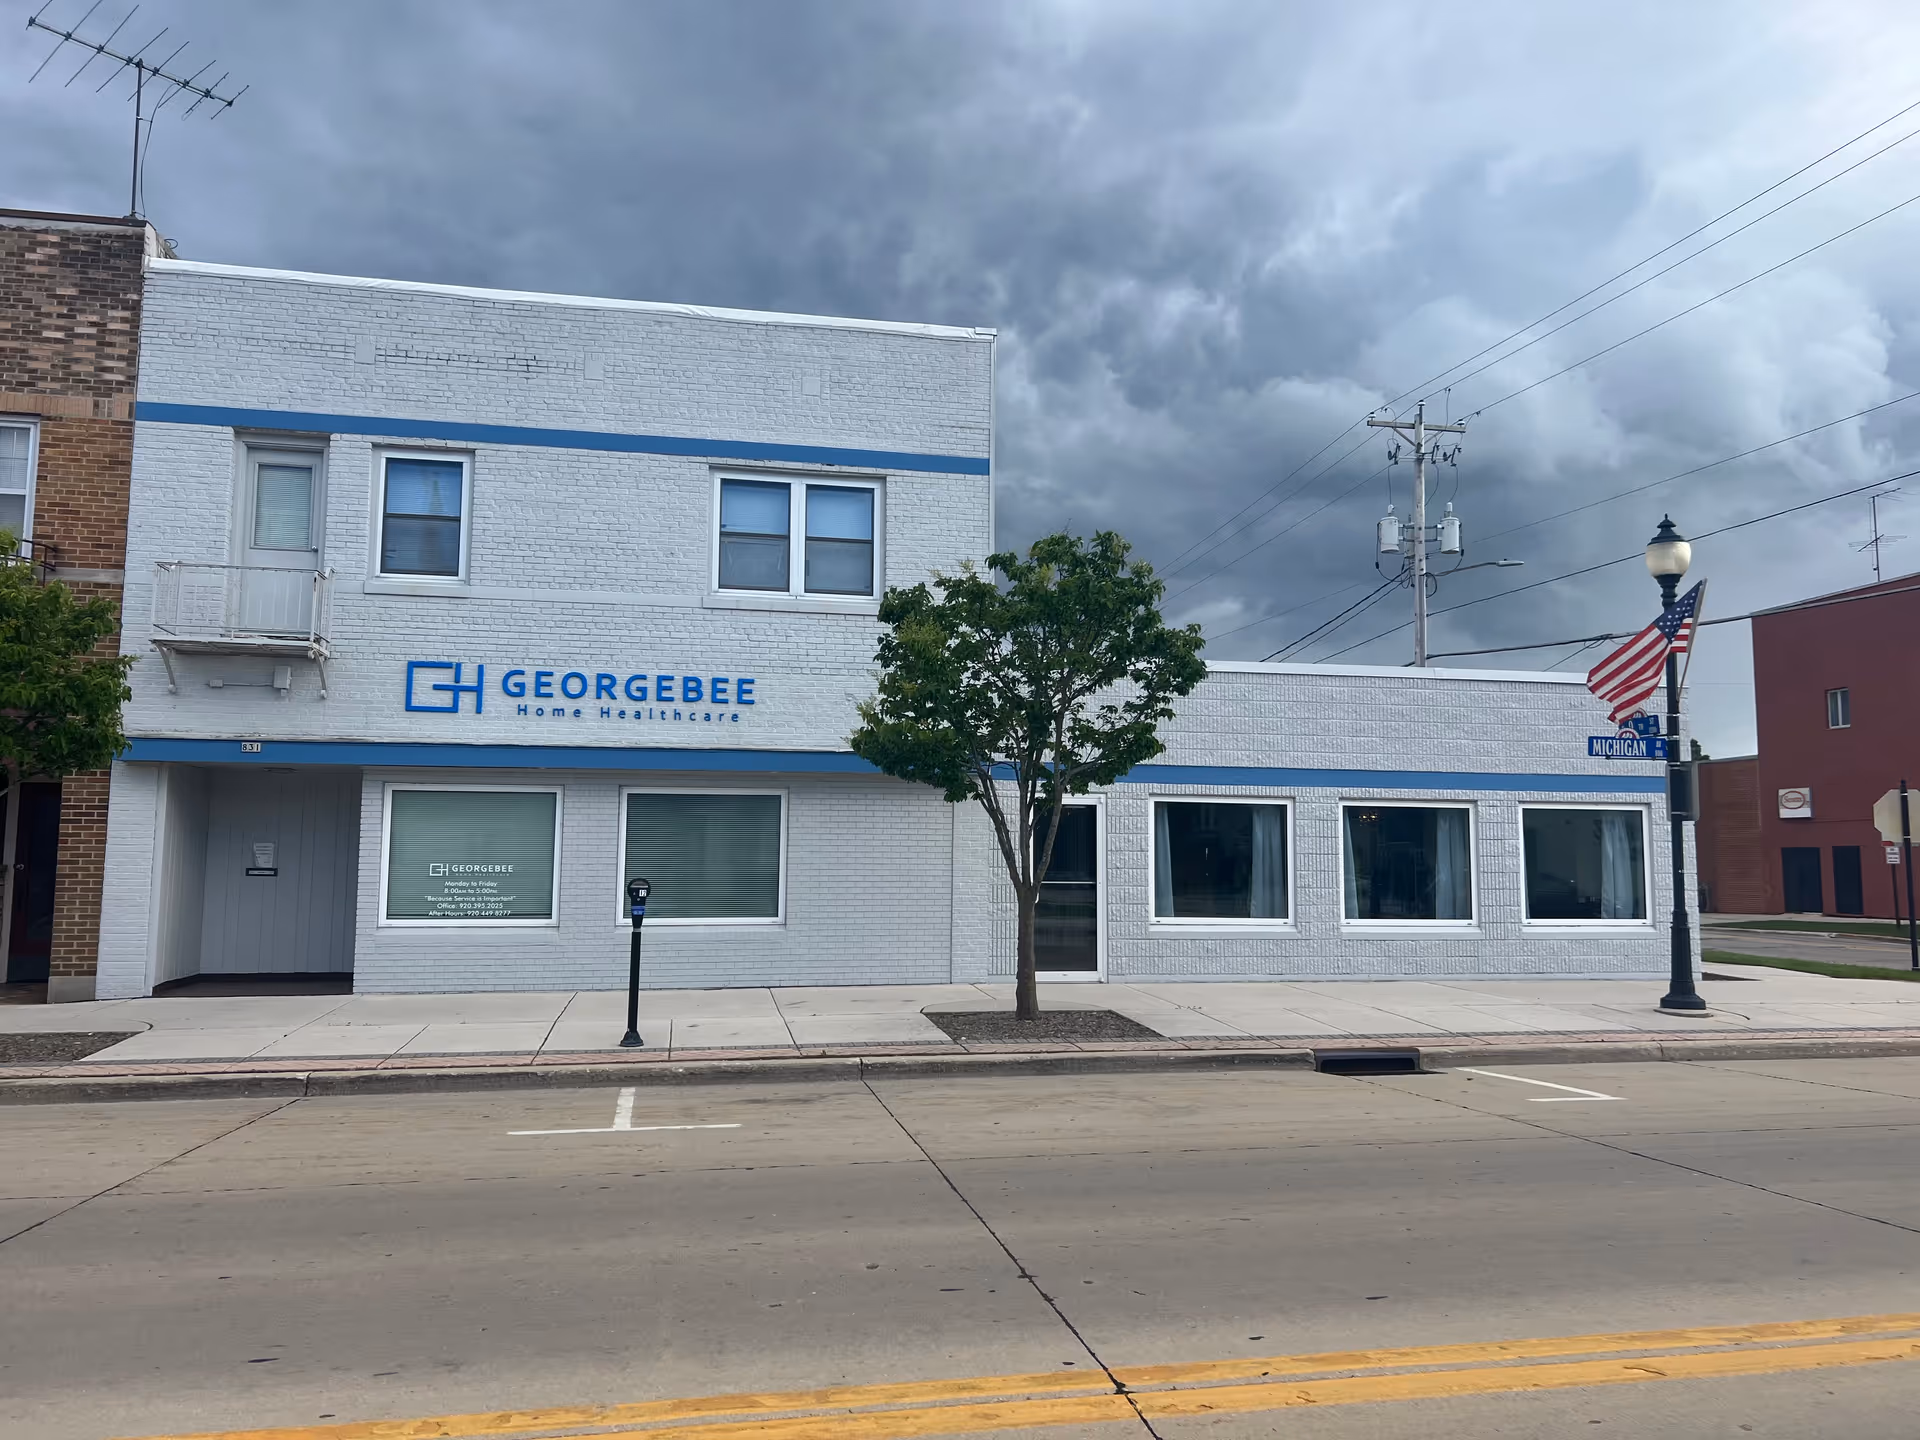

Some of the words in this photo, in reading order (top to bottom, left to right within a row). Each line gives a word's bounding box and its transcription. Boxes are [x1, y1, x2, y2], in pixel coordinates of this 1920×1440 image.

[502, 669, 756, 705] GEORGEBEE
[517, 703, 582, 718] Home
[600, 706, 739, 723] Healthcare
[242, 743, 259, 751] 831
[1592, 739, 1647, 756] MICHIGAN
[451, 864, 514, 873] GEORGEBEE
